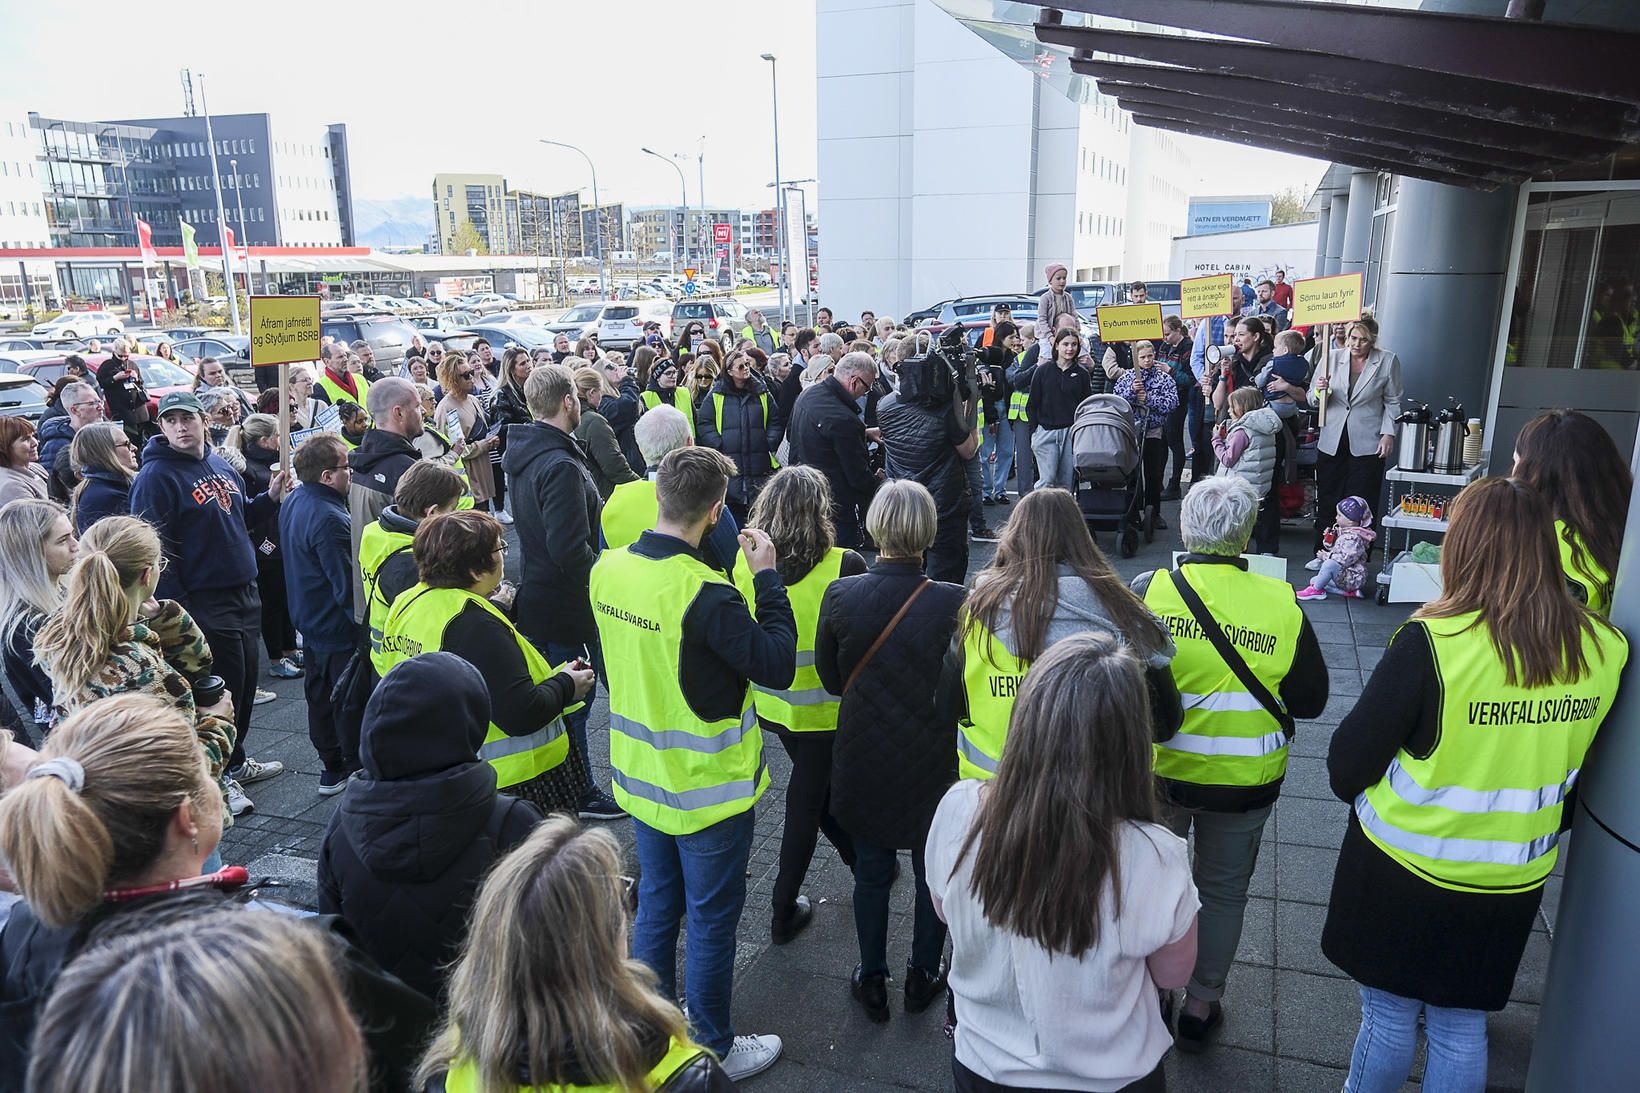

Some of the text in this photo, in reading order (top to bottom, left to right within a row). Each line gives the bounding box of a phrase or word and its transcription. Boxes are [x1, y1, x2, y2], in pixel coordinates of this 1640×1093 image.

[1194, 263, 1251, 271] HOTEL CABIN
[1299, 293, 1321, 302] Sömu
[1322, 291, 1338, 300] laun
[1307, 300, 1345, 312] sömu störf
[260, 316, 312, 330] Áfram jafnrétti
[1103, 317, 1158, 329] Eyðum misrétti
[253, 330, 319, 347] og Styðjum BSRB
[191, 478, 241, 506] BEARS
[1468, 694, 1601, 726] VERKFALLSVÖRÐUR
